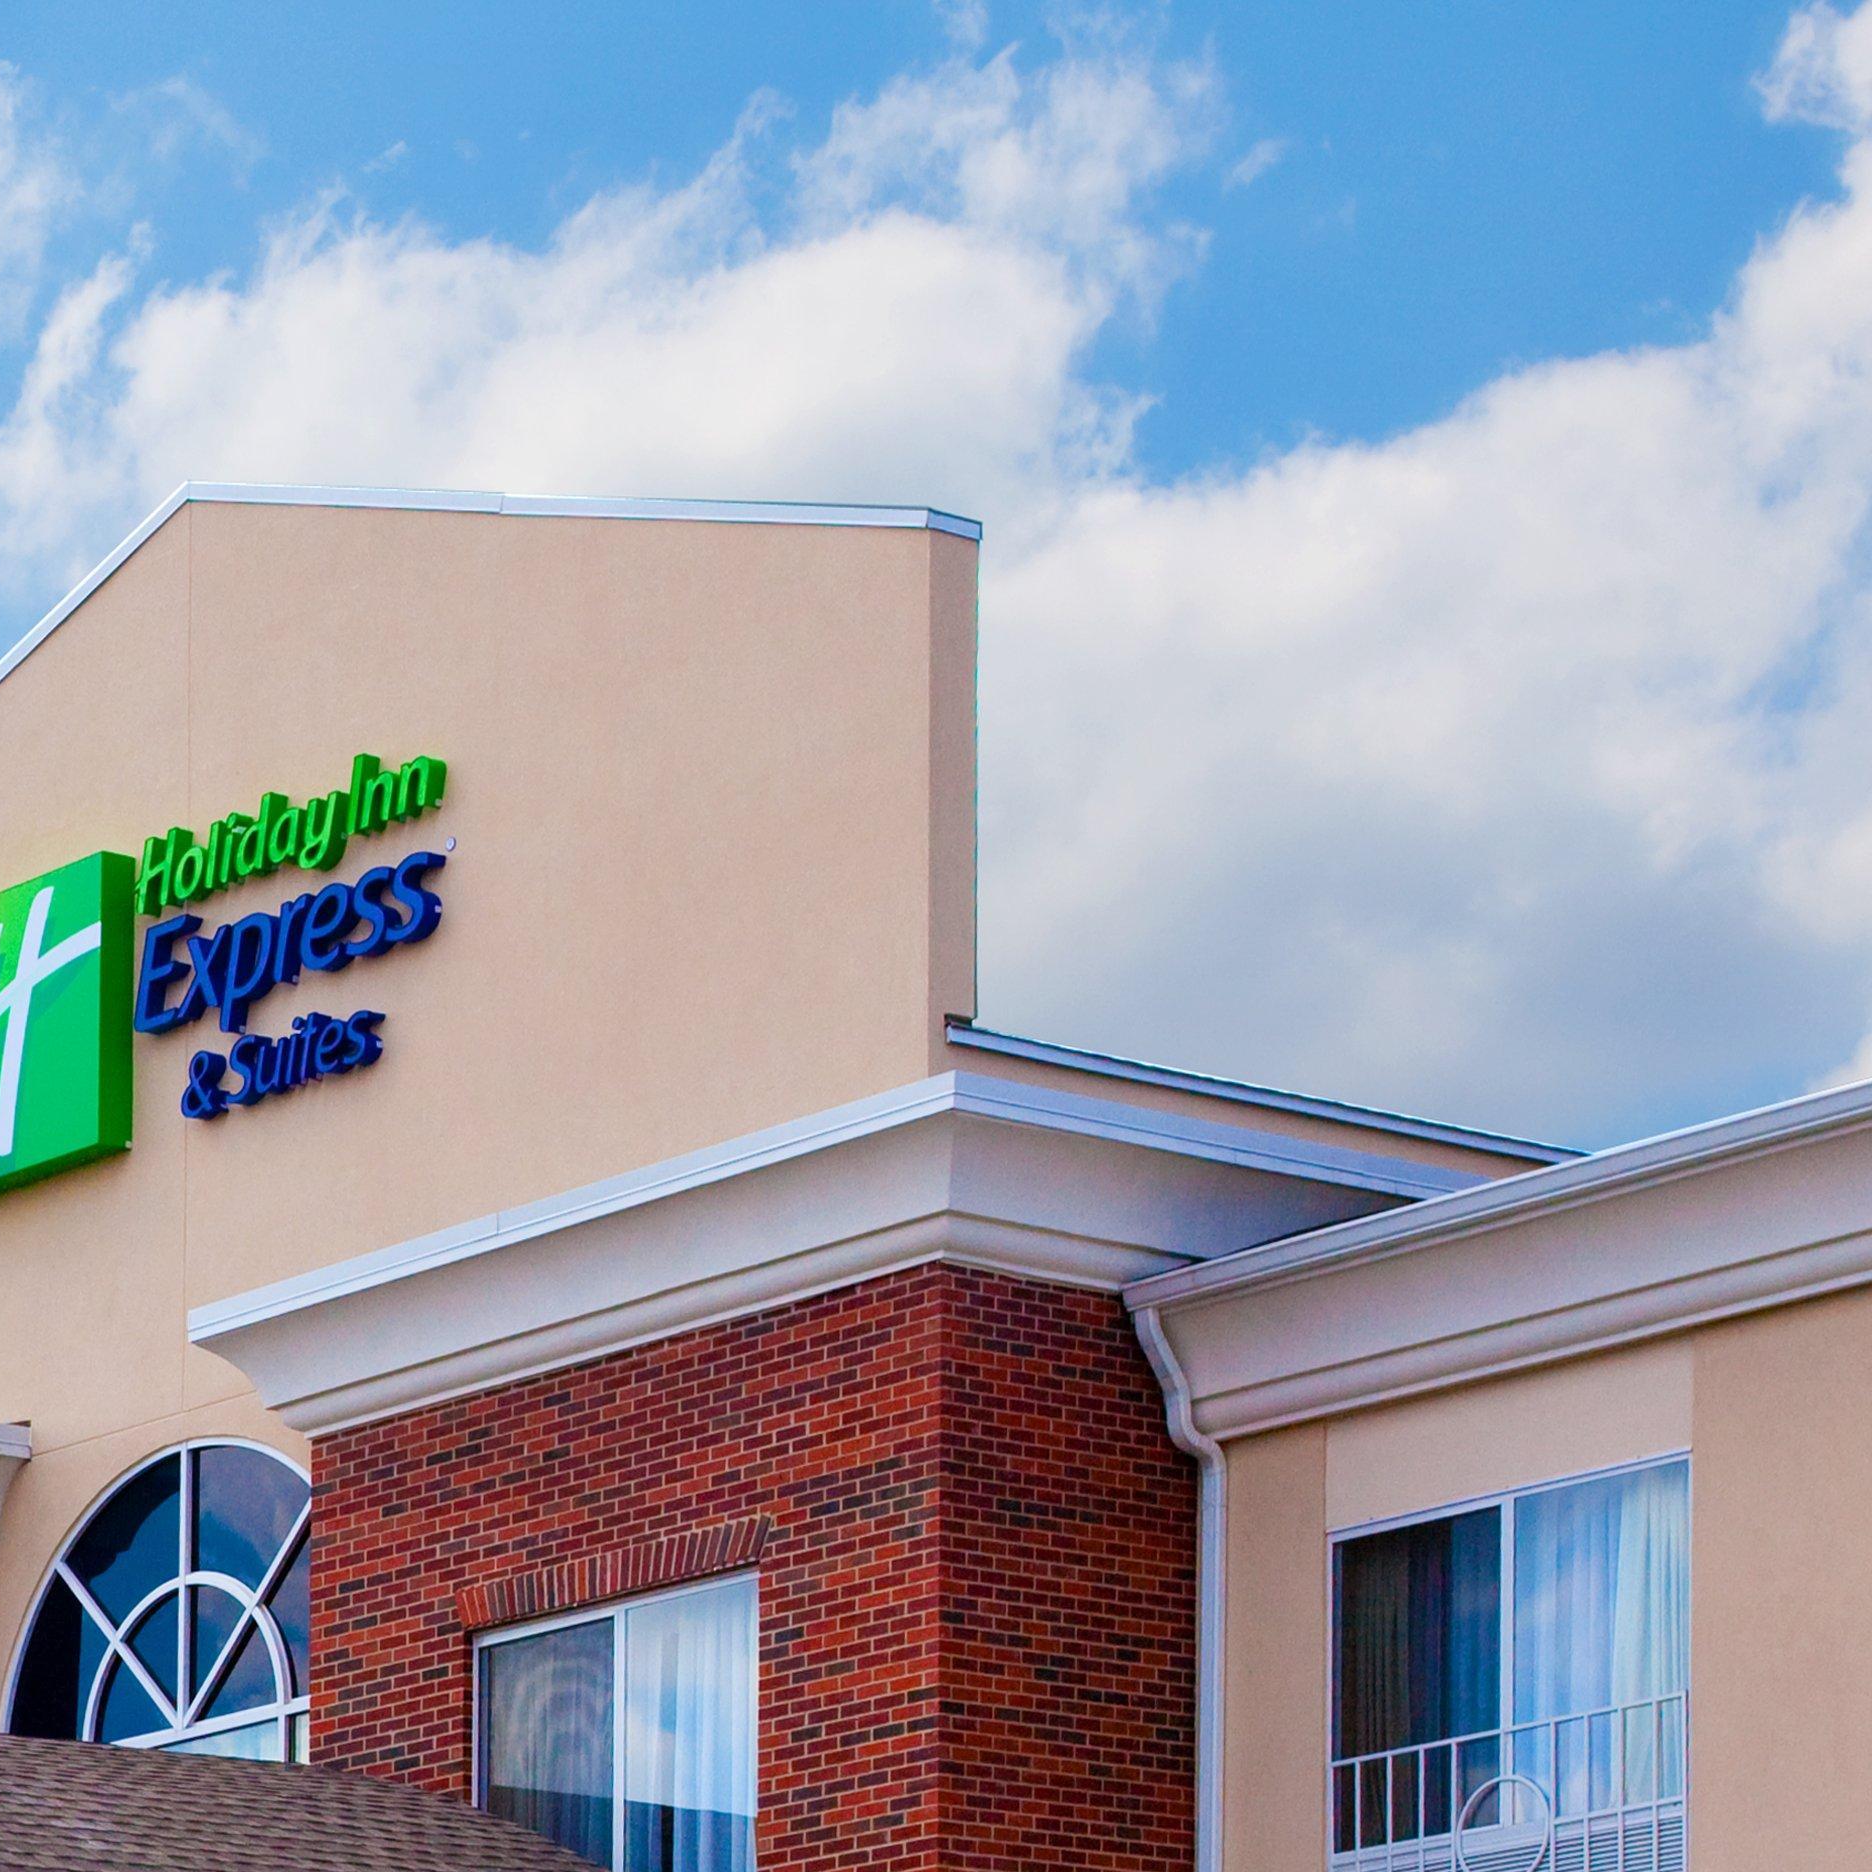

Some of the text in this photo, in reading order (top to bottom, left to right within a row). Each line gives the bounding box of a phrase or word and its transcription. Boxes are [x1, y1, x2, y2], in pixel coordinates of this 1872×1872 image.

[136, 753, 448, 917] Holiday Inn
[134, 851, 447, 1034] Express
[181, 1010, 386, 1120] & Suites
